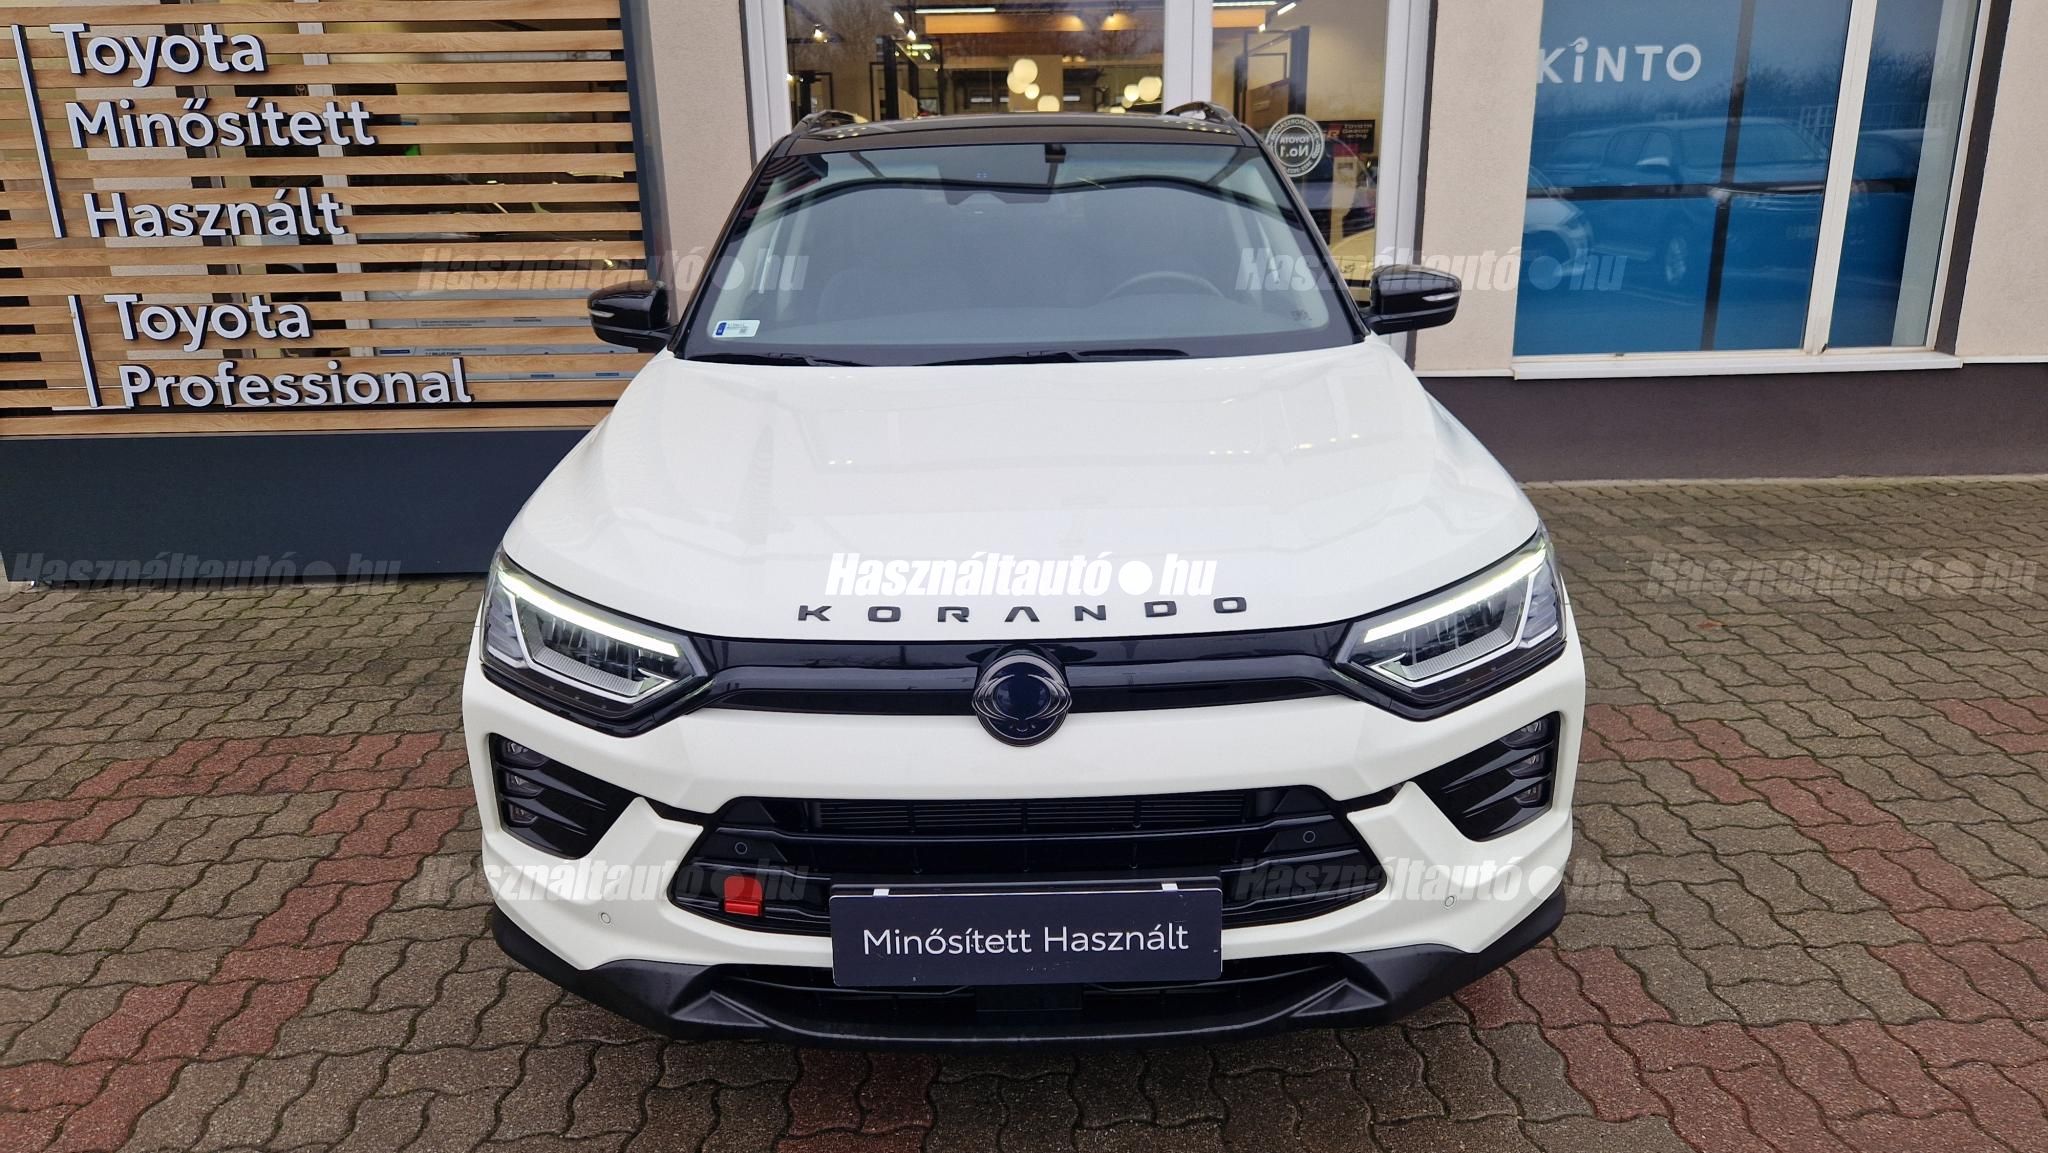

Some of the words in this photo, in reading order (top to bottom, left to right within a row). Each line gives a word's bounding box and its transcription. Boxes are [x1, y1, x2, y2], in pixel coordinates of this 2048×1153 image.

[50, 23, 266, 87] Toyota
[65, 98, 377, 149] Minősített
[83, 187, 347, 239] Használt
[104, 294, 313, 352] Toyota
[118, 357, 473, 408] Professional
[797, 596, 1248, 624] KORANDO
[863, 927, 1032, 955] Minősített
[1043, 922, 1189, 953] Használt
